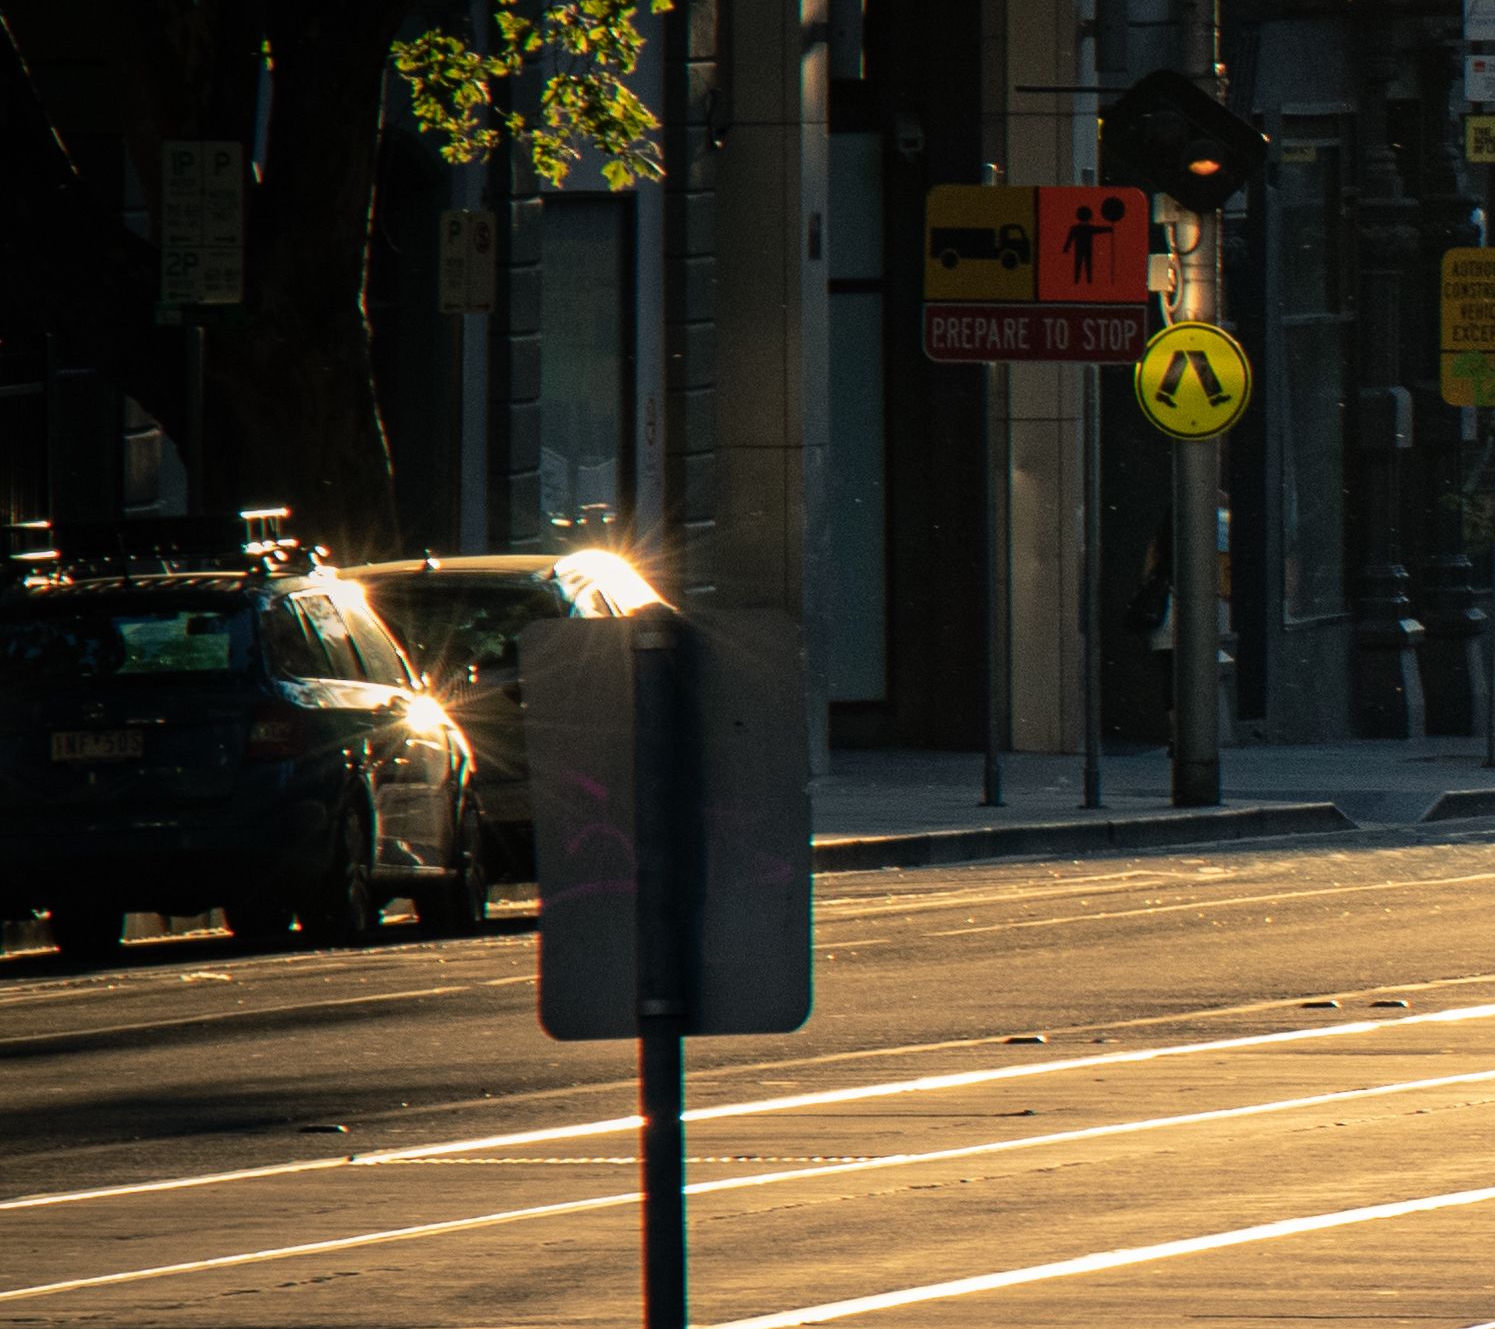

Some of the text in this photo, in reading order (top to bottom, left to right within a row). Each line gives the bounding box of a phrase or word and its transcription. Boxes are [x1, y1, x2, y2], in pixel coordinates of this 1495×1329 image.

[166, 252, 199, 276] 2P
[931, 317, 1138, 352] PREPARE TO STOP
